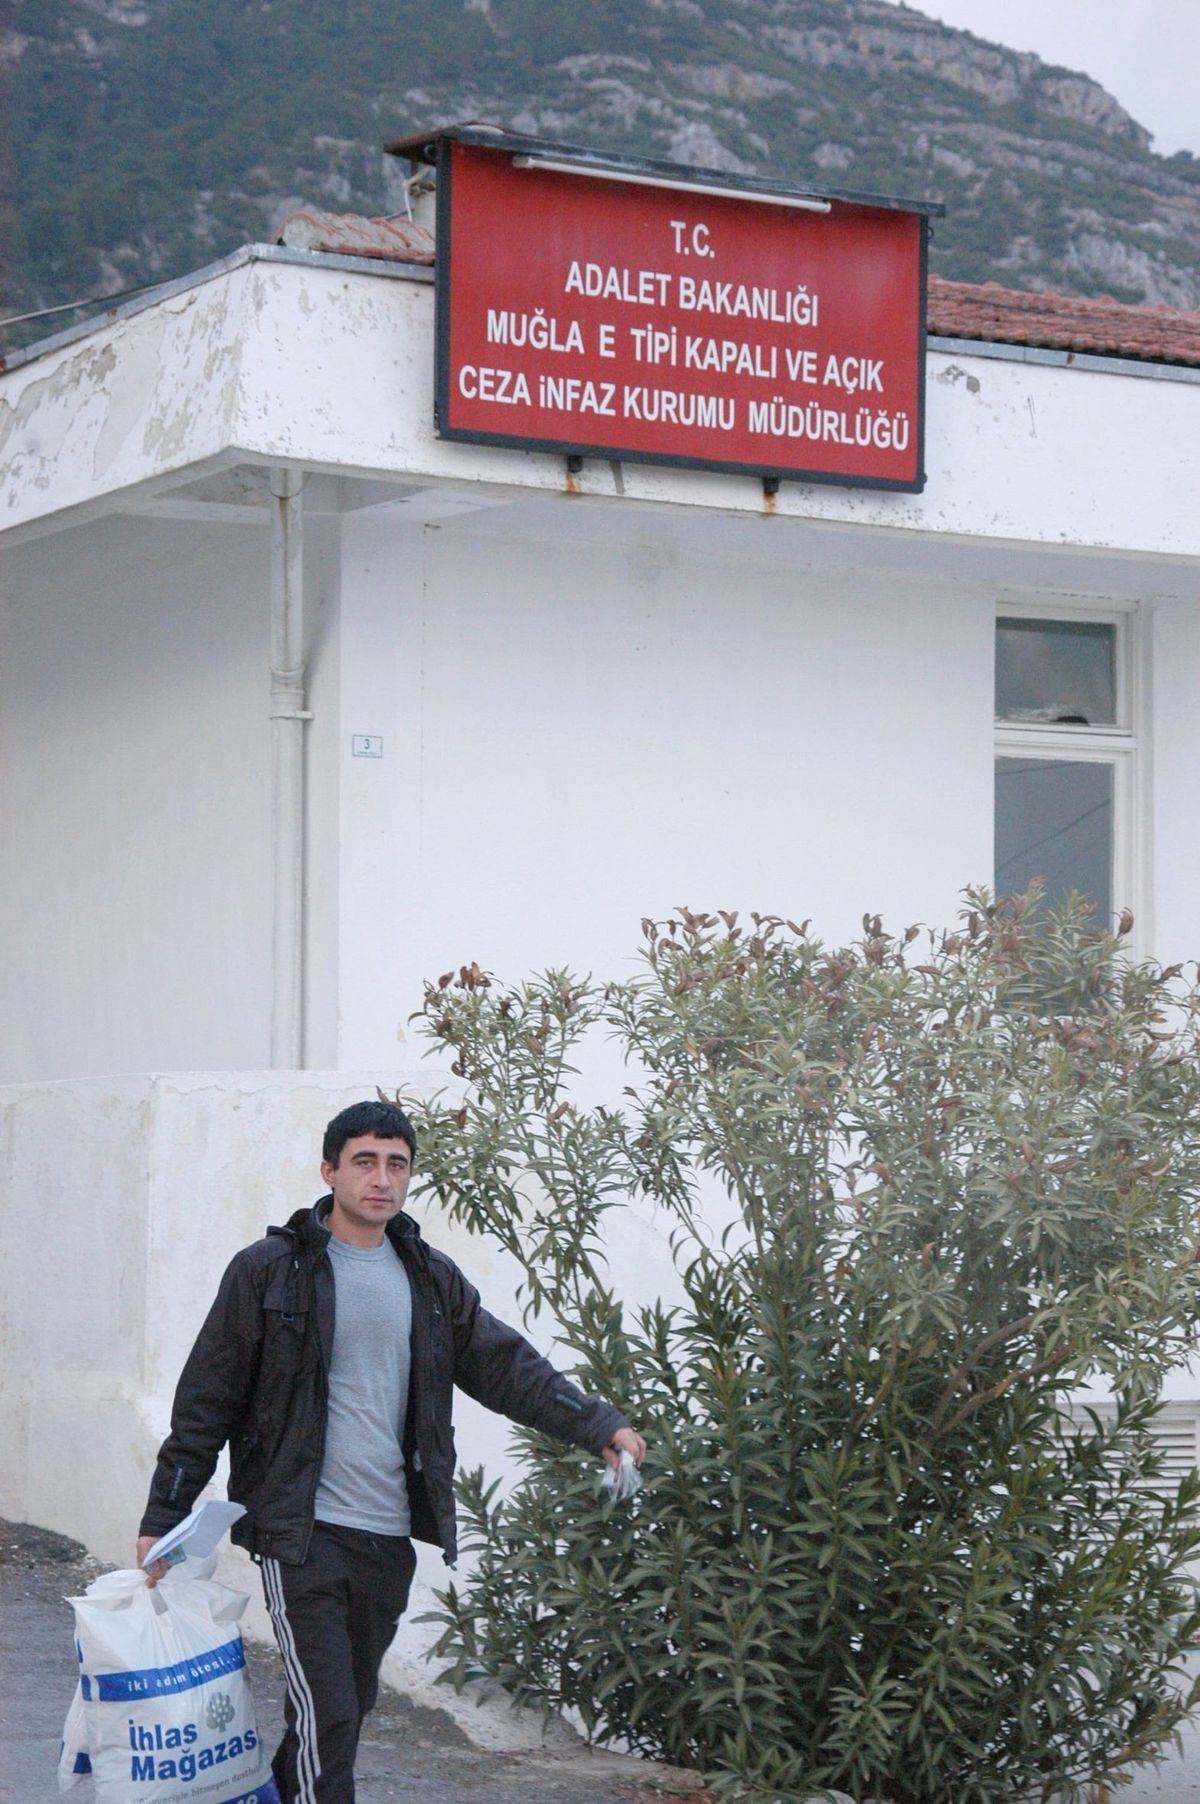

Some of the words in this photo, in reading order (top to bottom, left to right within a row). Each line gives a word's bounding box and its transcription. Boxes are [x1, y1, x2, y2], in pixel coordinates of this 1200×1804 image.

[670, 220, 716, 258] T.C.
[564, 261, 672, 307] ADALET
[679, 276, 819, 327] BAKANLIĞI
[486, 308, 585, 354] MUĞLA
[599, 325, 617, 358] E
[630, 323, 677, 366] TİPİ
[684, 336, 777, 378] KAPALI
[785, 350, 818, 384] VE
[823, 354, 885, 395] AÇIK
[458, 365, 532, 407] CEZA
[623, 385, 736, 431] KURUMU
[748, 396, 910, 451] MÜDÜRLÜĞÜ
[363, 738, 371, 750] 3
[128, 1679, 148, 1692] iki
